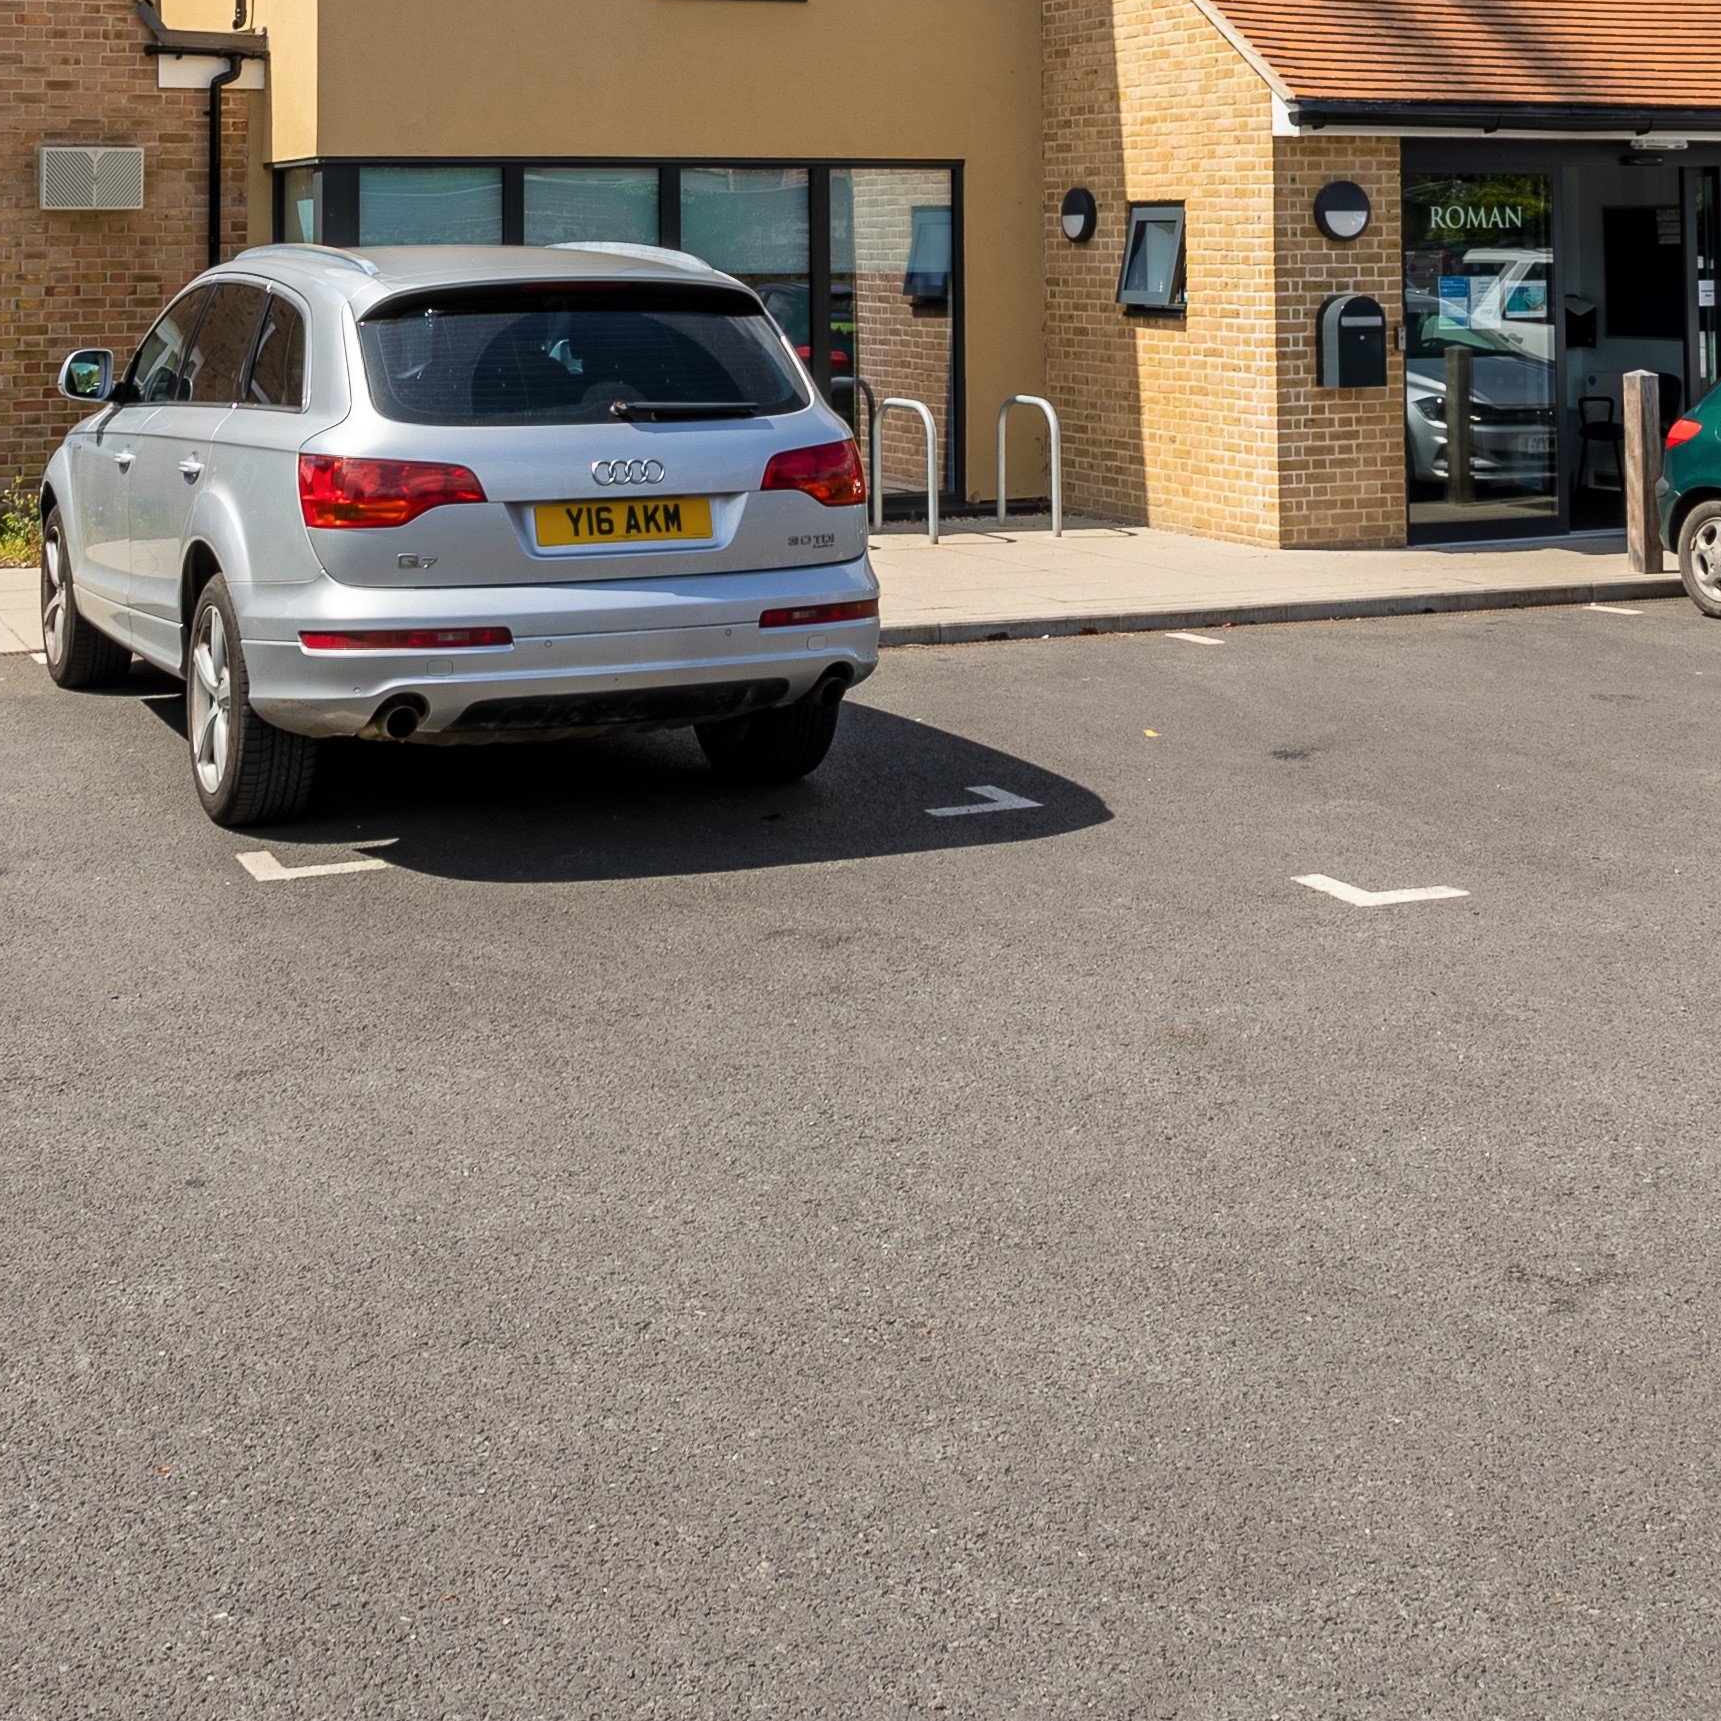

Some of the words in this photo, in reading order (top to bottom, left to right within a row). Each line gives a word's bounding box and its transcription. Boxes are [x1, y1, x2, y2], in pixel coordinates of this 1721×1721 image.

[1430, 206, 1522, 229] ROMAN
[565, 506, 615, 537] Y16
[625, 503, 683, 534] AKM
